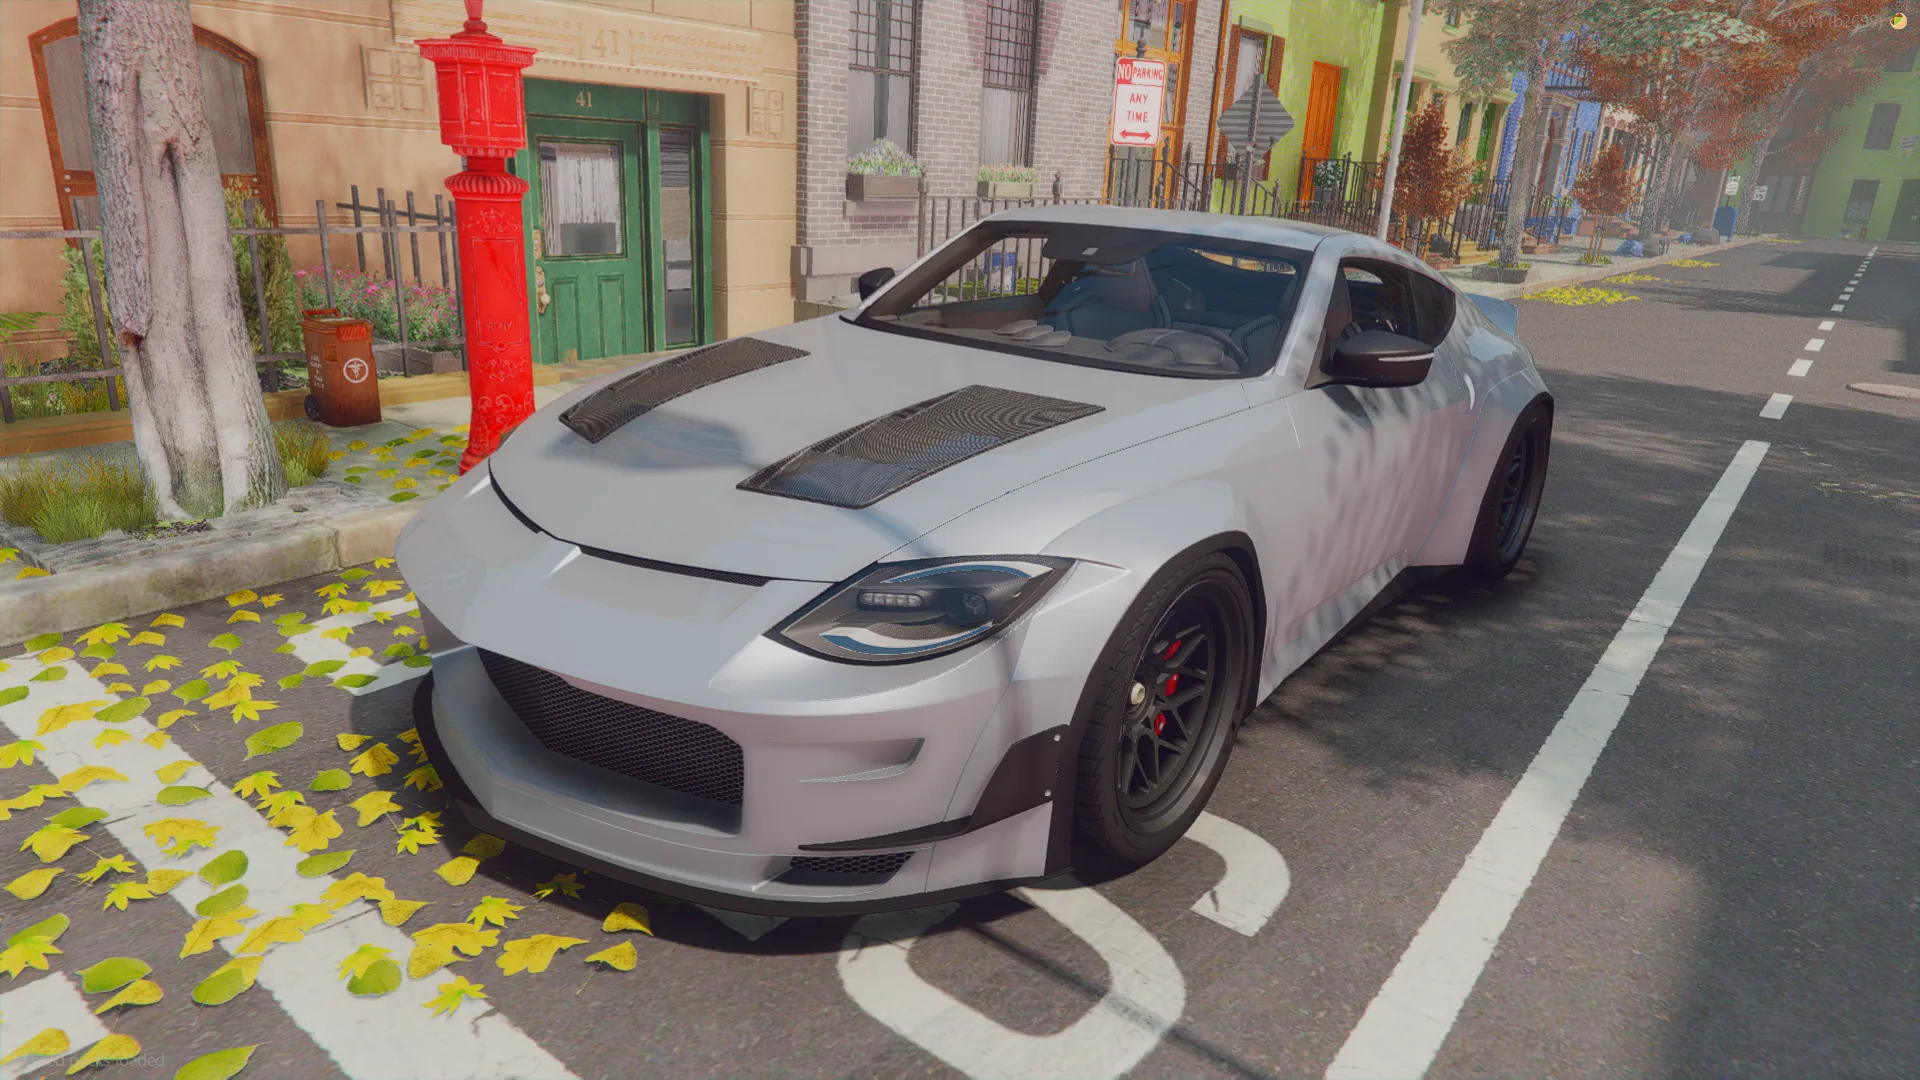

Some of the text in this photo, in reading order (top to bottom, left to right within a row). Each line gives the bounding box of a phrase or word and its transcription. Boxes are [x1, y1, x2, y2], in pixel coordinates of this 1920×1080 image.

[591, 29, 619, 58] 41
[1118, 63, 1164, 80] NO PARKING
[576, 91, 593, 107] 41
[1129, 93, 1149, 105] ANY
[1127, 110, 1149, 122] TIME
